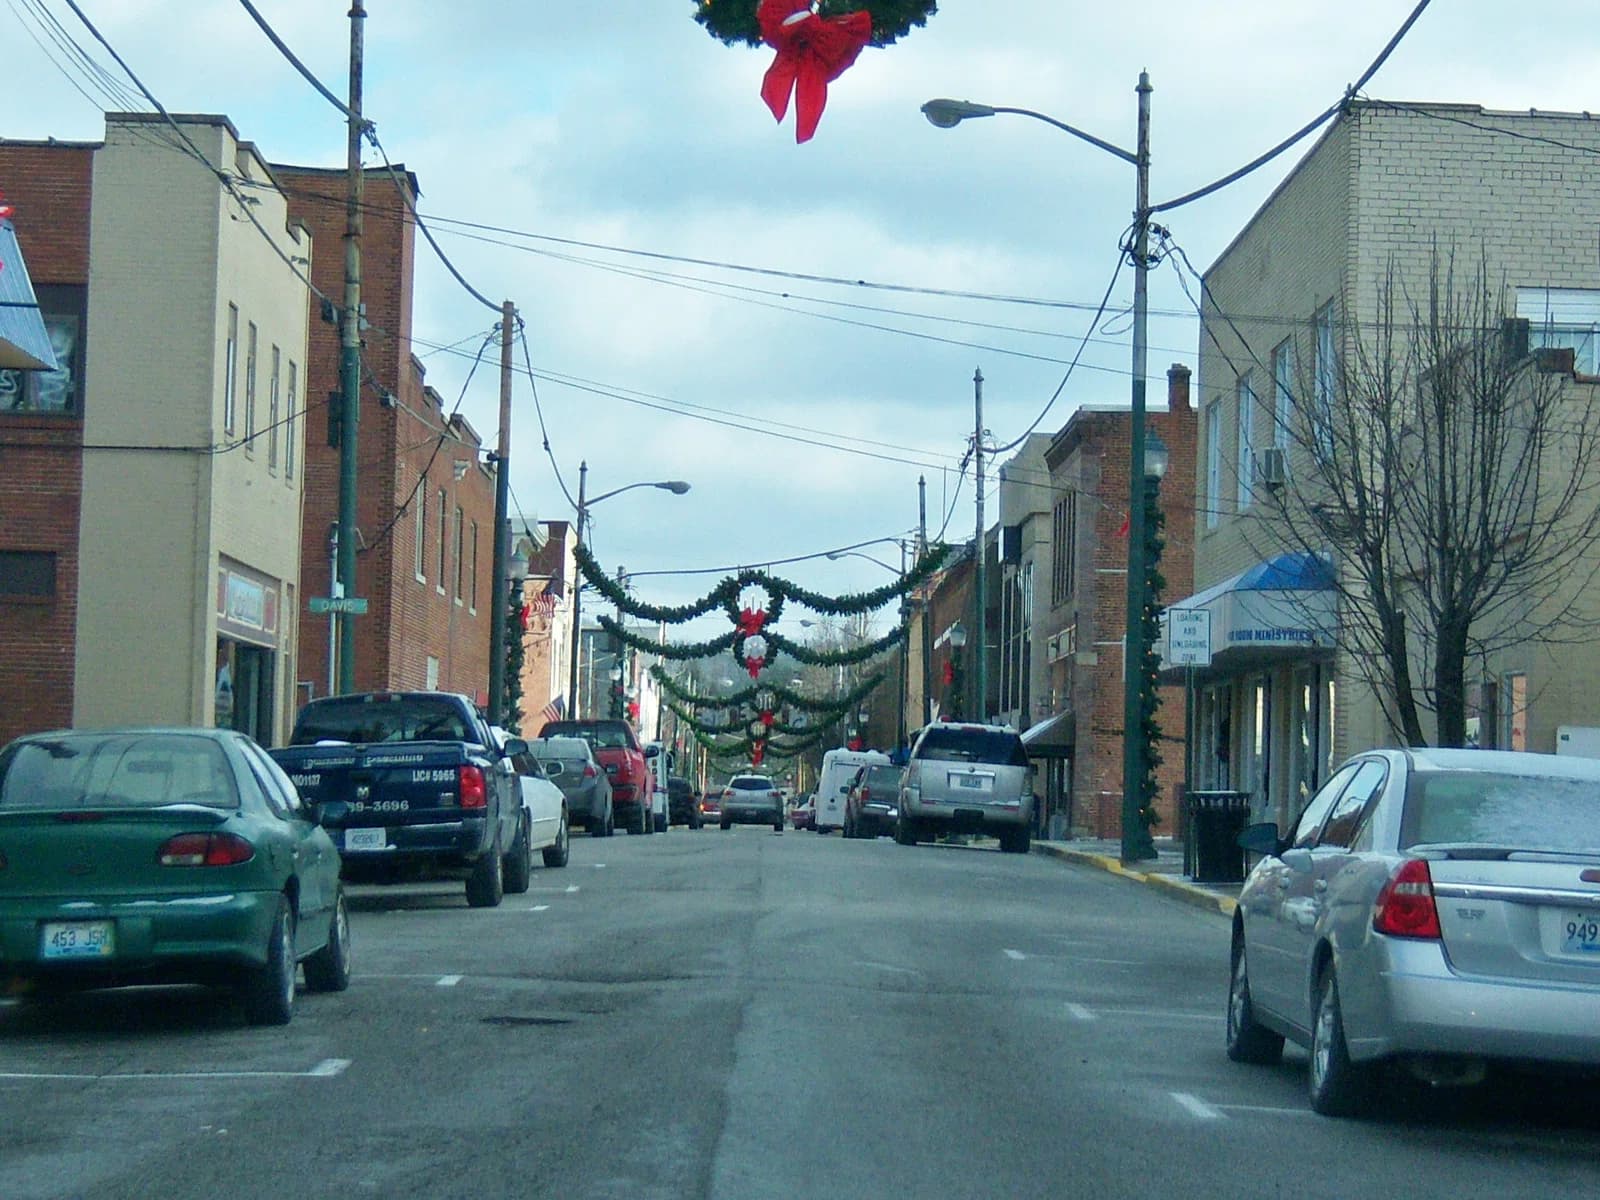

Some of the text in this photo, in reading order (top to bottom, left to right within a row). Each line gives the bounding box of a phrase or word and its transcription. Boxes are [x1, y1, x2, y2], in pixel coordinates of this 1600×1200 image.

[321, 599, 353, 612] DAVIS
[1176, 613, 1204, 622] LOADING
[1183, 626, 1197, 636] AND
[1255, 629, 1314, 641] MINISTRIES
[1172, 639, 1208, 649] UNLOADING
[1181, 653, 1197, 662] ZONE
[1566, 922, 1598, 941] 949
[52, 931, 76, 947] 453
